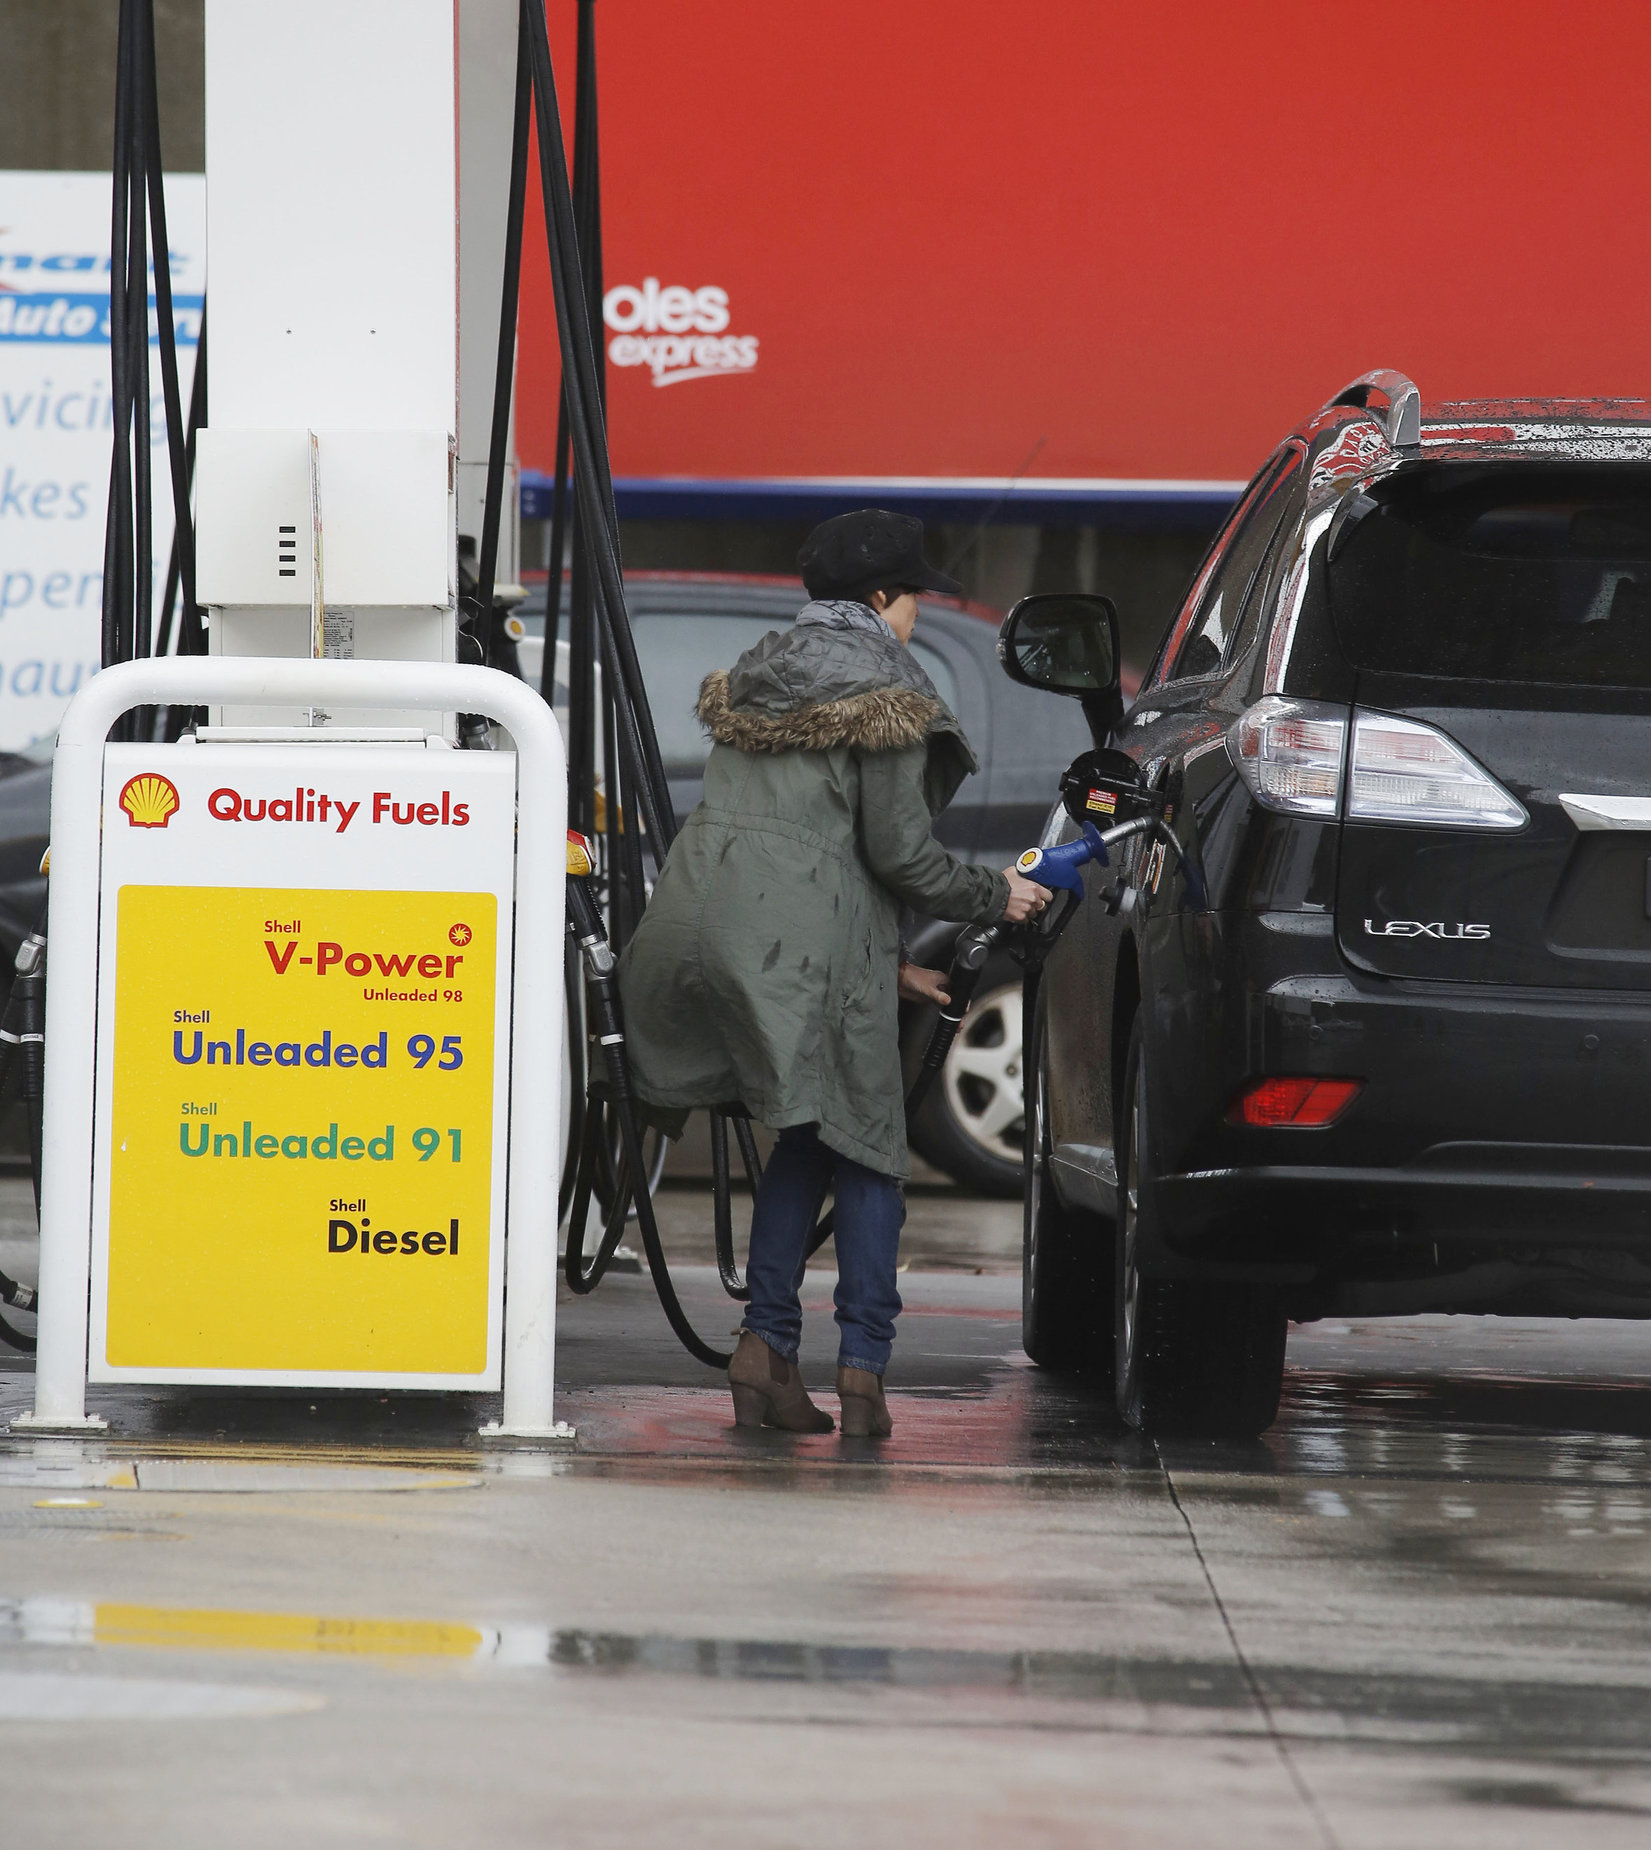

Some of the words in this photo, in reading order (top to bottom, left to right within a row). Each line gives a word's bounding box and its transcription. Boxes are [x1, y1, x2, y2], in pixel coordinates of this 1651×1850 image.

[603, 277, 730, 333] oles
[608, 334, 759, 381] express
[208, 788, 360, 833] Quality
[373, 791, 470, 827] Fuels
[264, 920, 301, 934] Shell
[1364, 919, 1491, 939] LEXUS
[264, 940, 464, 979] V-Power
[363, 987, 438, 1003] Unleaded
[443, 989, 464, 1003] 98
[173, 1010, 211, 1025] Shell
[173, 1028, 388, 1069] Unleaded
[407, 1033, 464, 1071] 95
[181, 1102, 218, 1116] Shell
[180, 1120, 395, 1161] Unleaded
[411, 1127, 462, 1163] 91
[329, 1199, 367, 1213] Shell
[328, 1217, 460, 1256] Diesel
